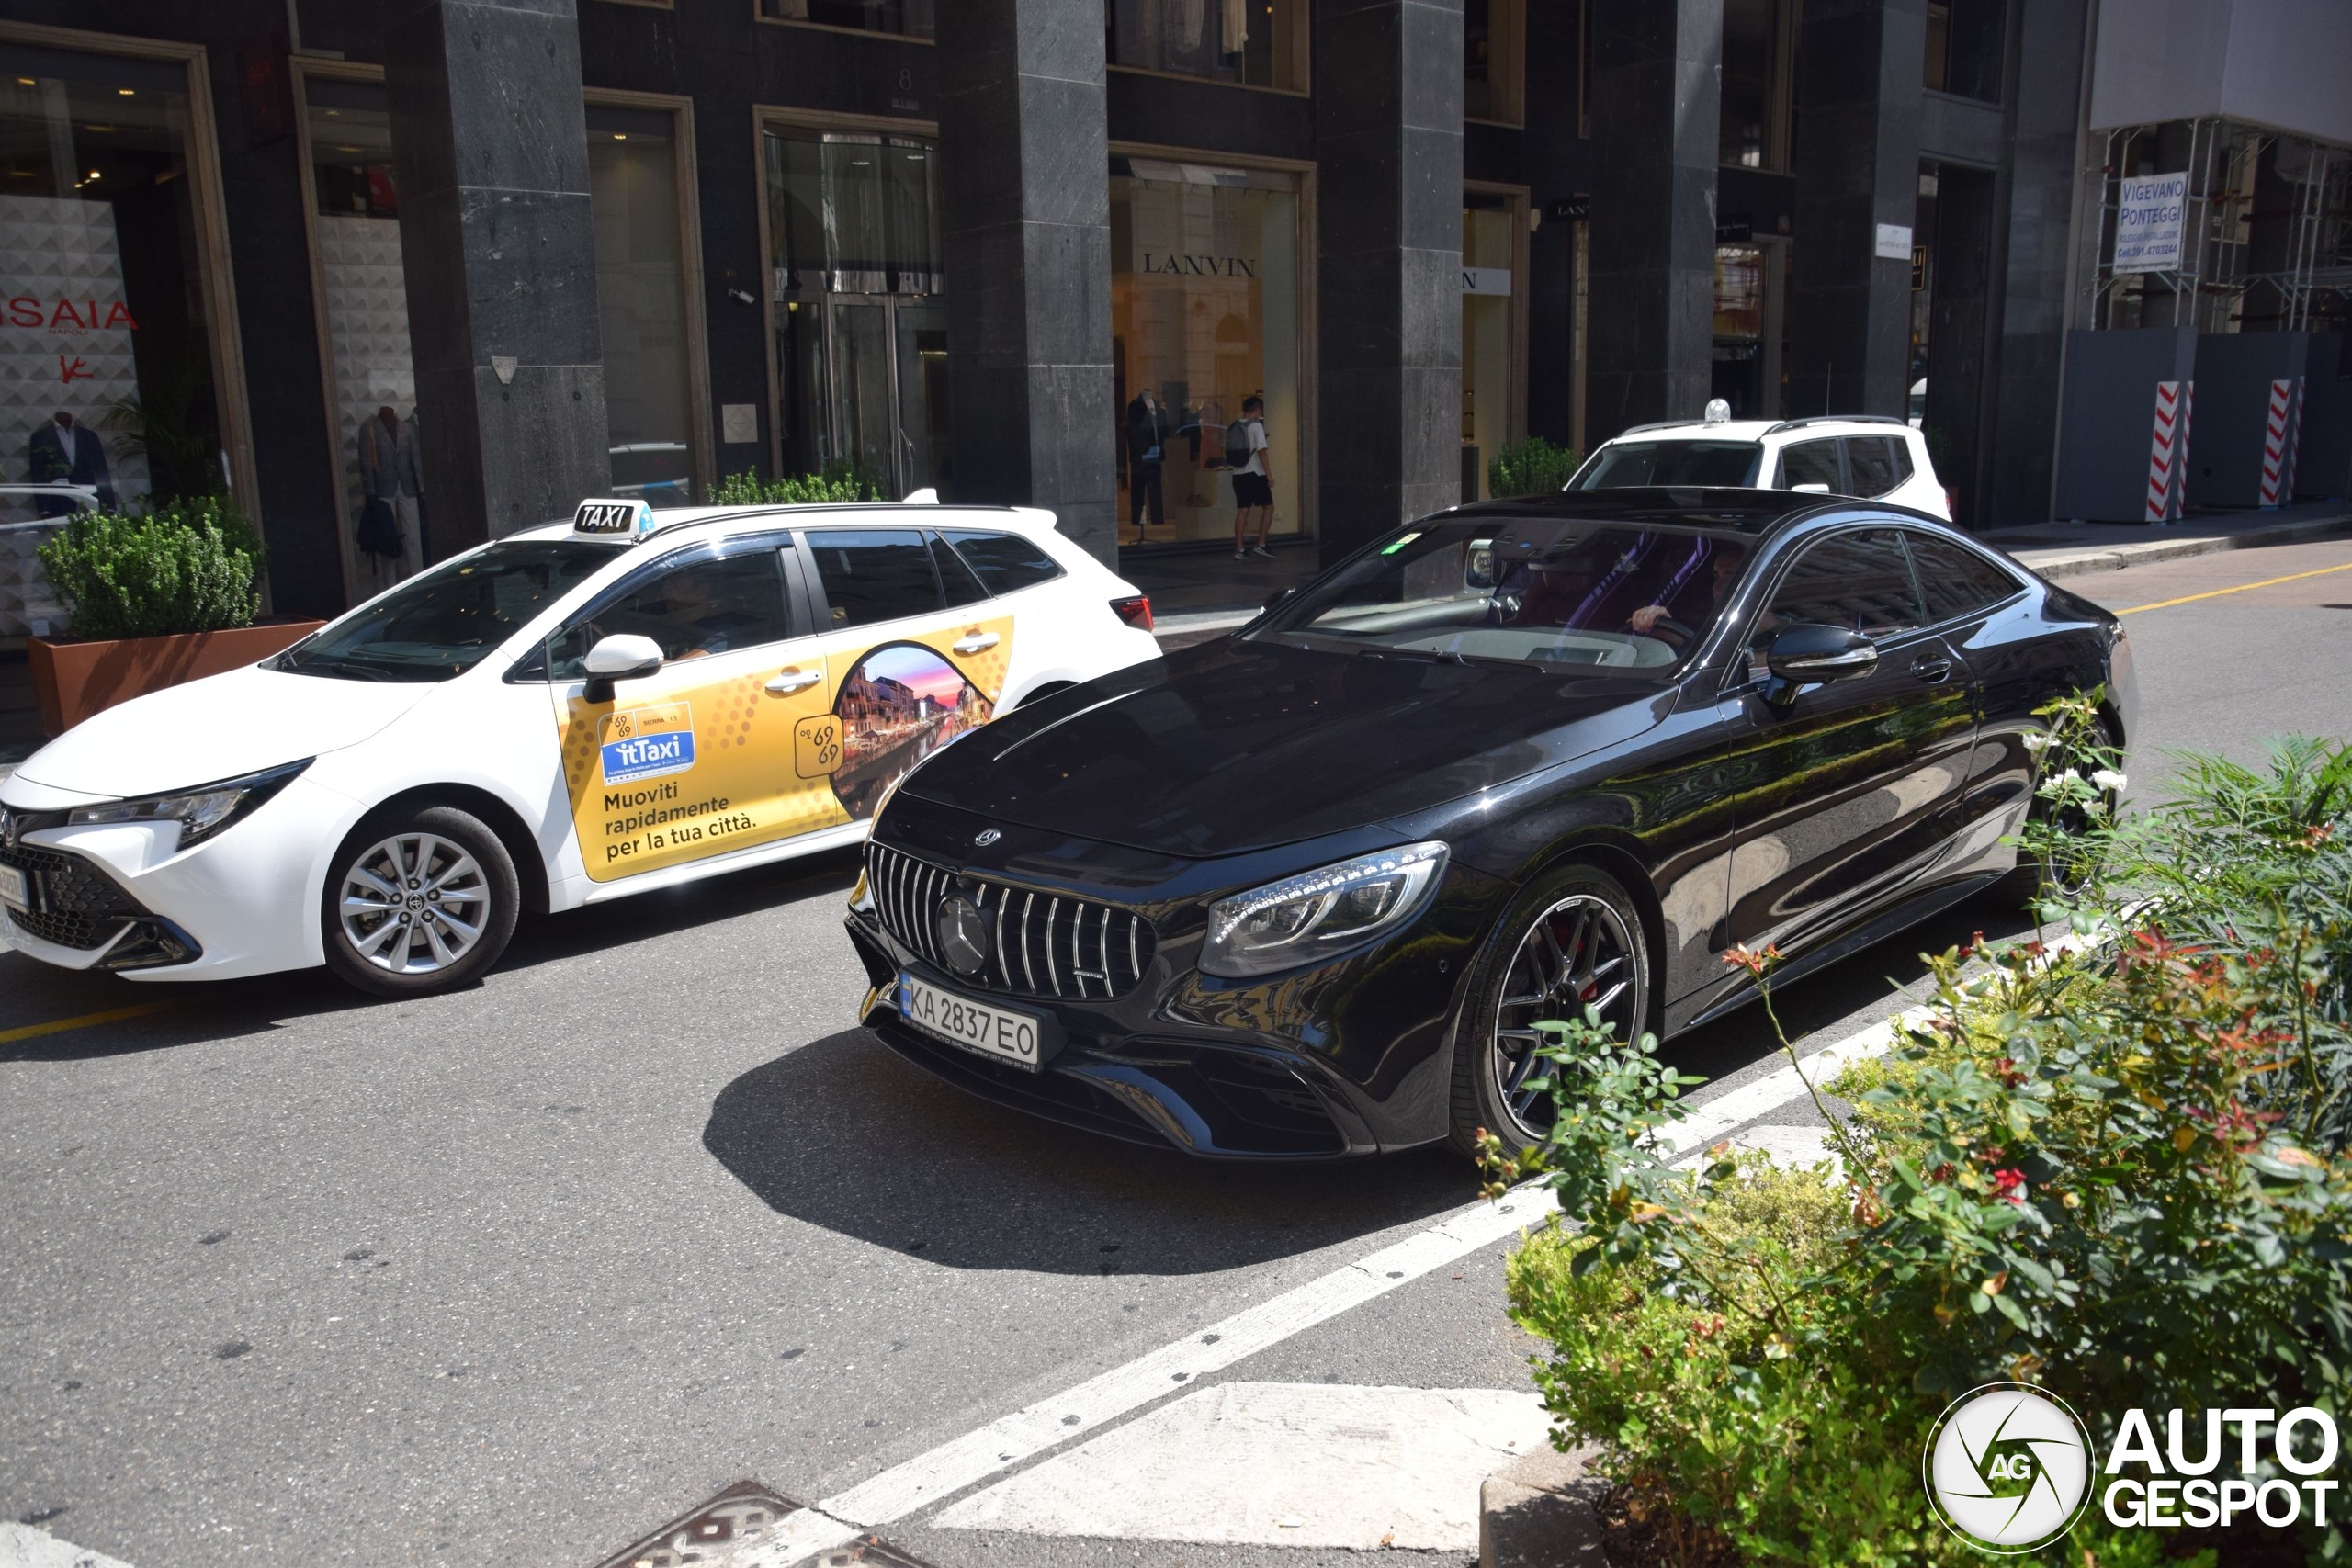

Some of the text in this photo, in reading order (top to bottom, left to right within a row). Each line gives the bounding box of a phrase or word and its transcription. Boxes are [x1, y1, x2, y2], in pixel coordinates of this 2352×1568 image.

[899, 69, 912, 91] 8
[2123, 180, 2184, 202] VIGEVANO
[2120, 205, 2182, 227] PONTEGGI
[1143, 253, 1256, 277] LANVIN
[582, 506, 627, 528] TAXI
[615, 716, 628, 728] 69
[618, 726, 631, 738] 69
[814, 726, 833, 746] 69
[616, 735, 680, 766] itTaxi
[819, 744, 838, 764] 69
[604, 781, 678, 812] Muoviti
[605, 796, 729, 836] rapidamente
[606, 812, 757, 863] per la tua città.
[903, 1000, 910, 1011] UA
[910, 982, 936, 1024] KA
[941, 998, 991, 1043] 2837
[997, 1016, 1035, 1055] EO
[931, 1031, 951, 1044] AUTO
[951, 1040, 989, 1057] GALLERY
